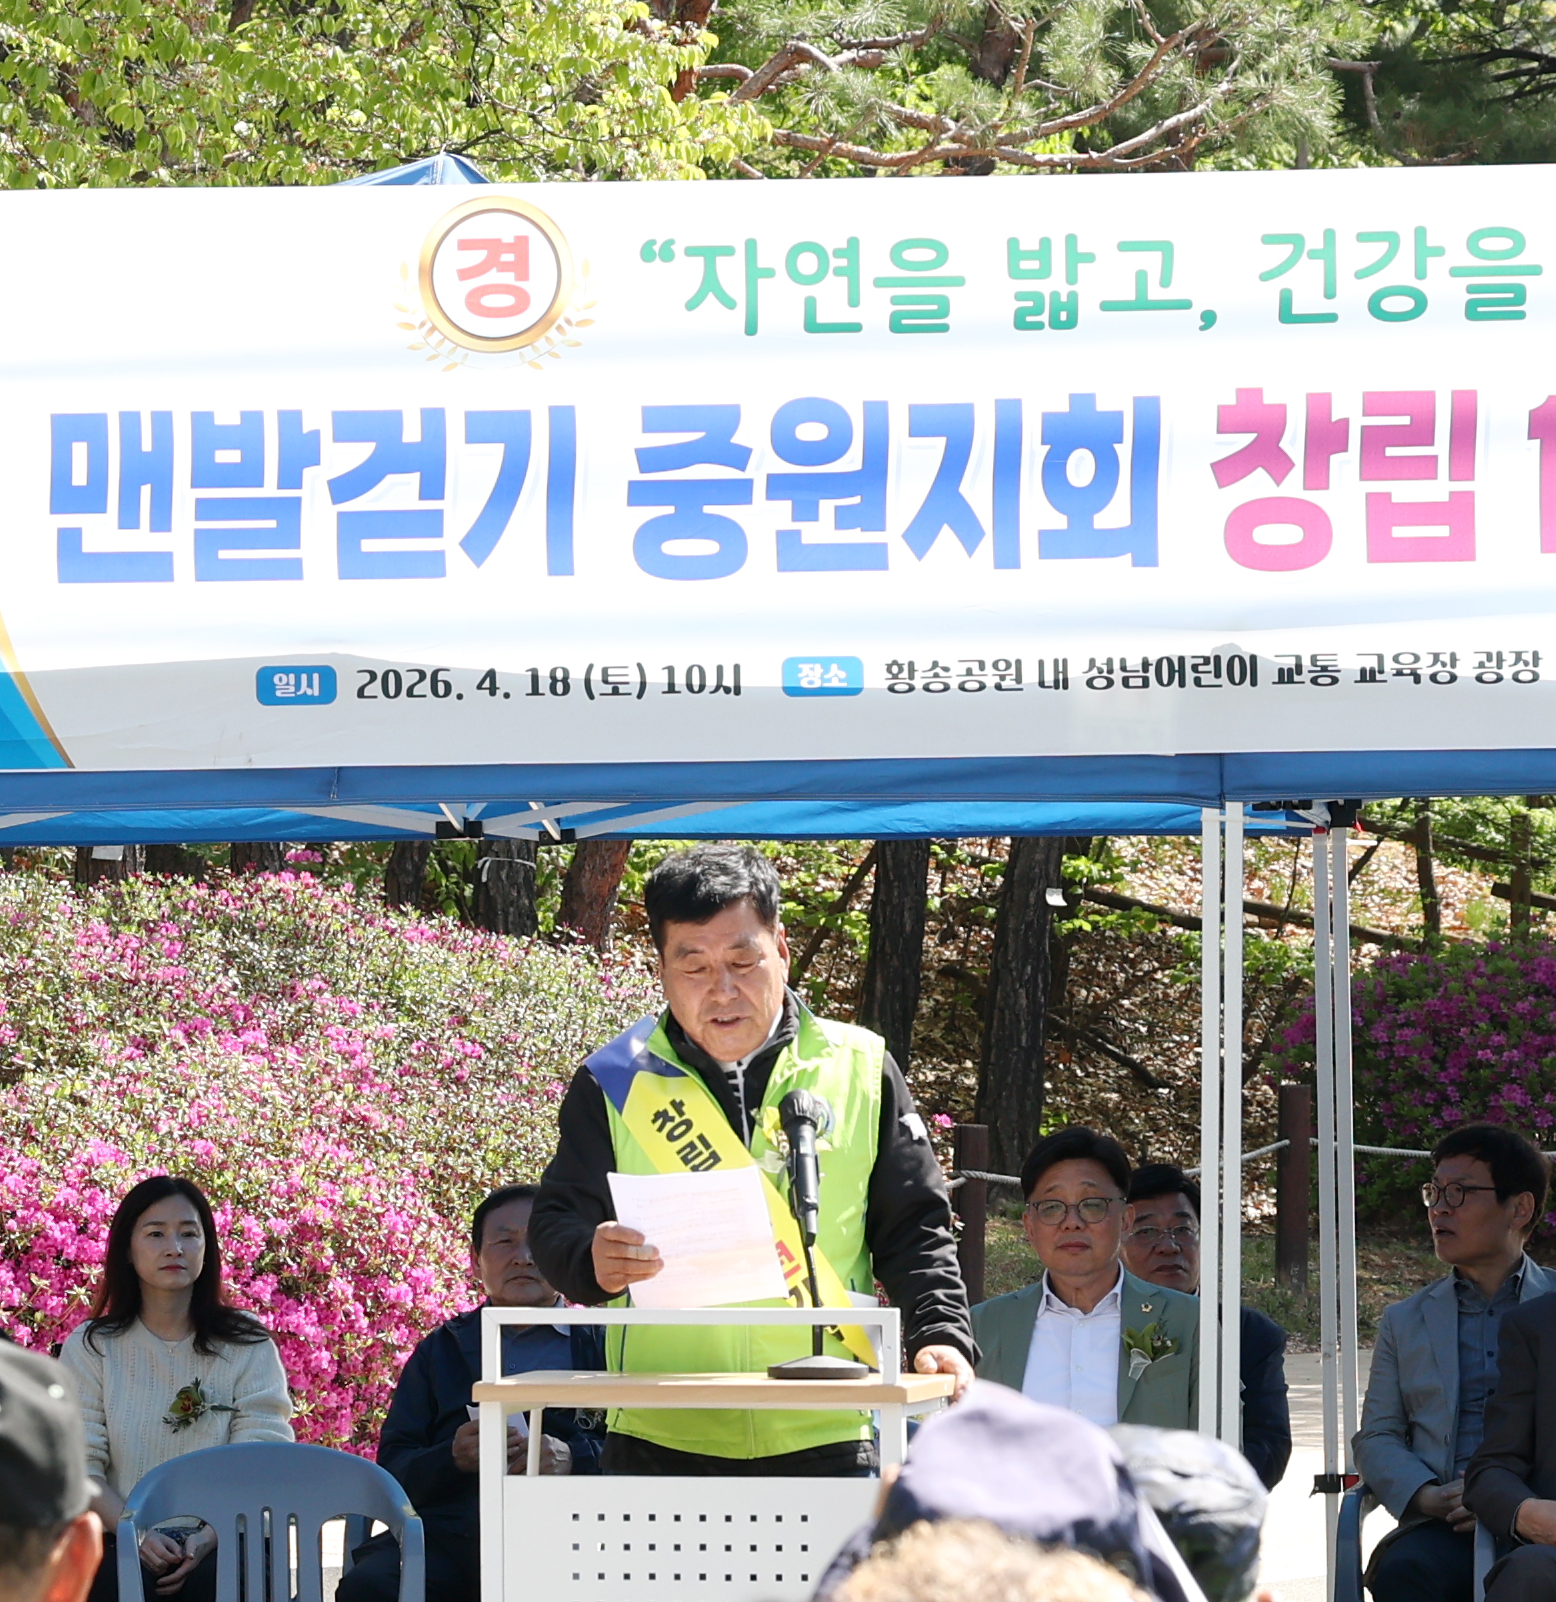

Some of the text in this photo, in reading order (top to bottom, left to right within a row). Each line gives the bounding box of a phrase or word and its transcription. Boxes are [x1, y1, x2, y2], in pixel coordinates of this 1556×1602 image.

[456, 233, 532, 319] 경
[639, 235, 967, 337] “자연을
[1007, 233, 1218, 332] 밟고,
[1259, 225, 1543, 325] 건강을
[48, 405, 578, 586] 맨발걷기
[625, 394, 1162, 581] 중원지회
[1210, 386, 1478, 572] 창립
[272, 672, 320, 698] 일시
[355, 662, 742, 701] 2026. 4. 18 (토) 10시
[797, 662, 848, 689] 장소
[884, 649, 1544, 694] 황송공원 내 성남어린이 교통 교육장 광장
